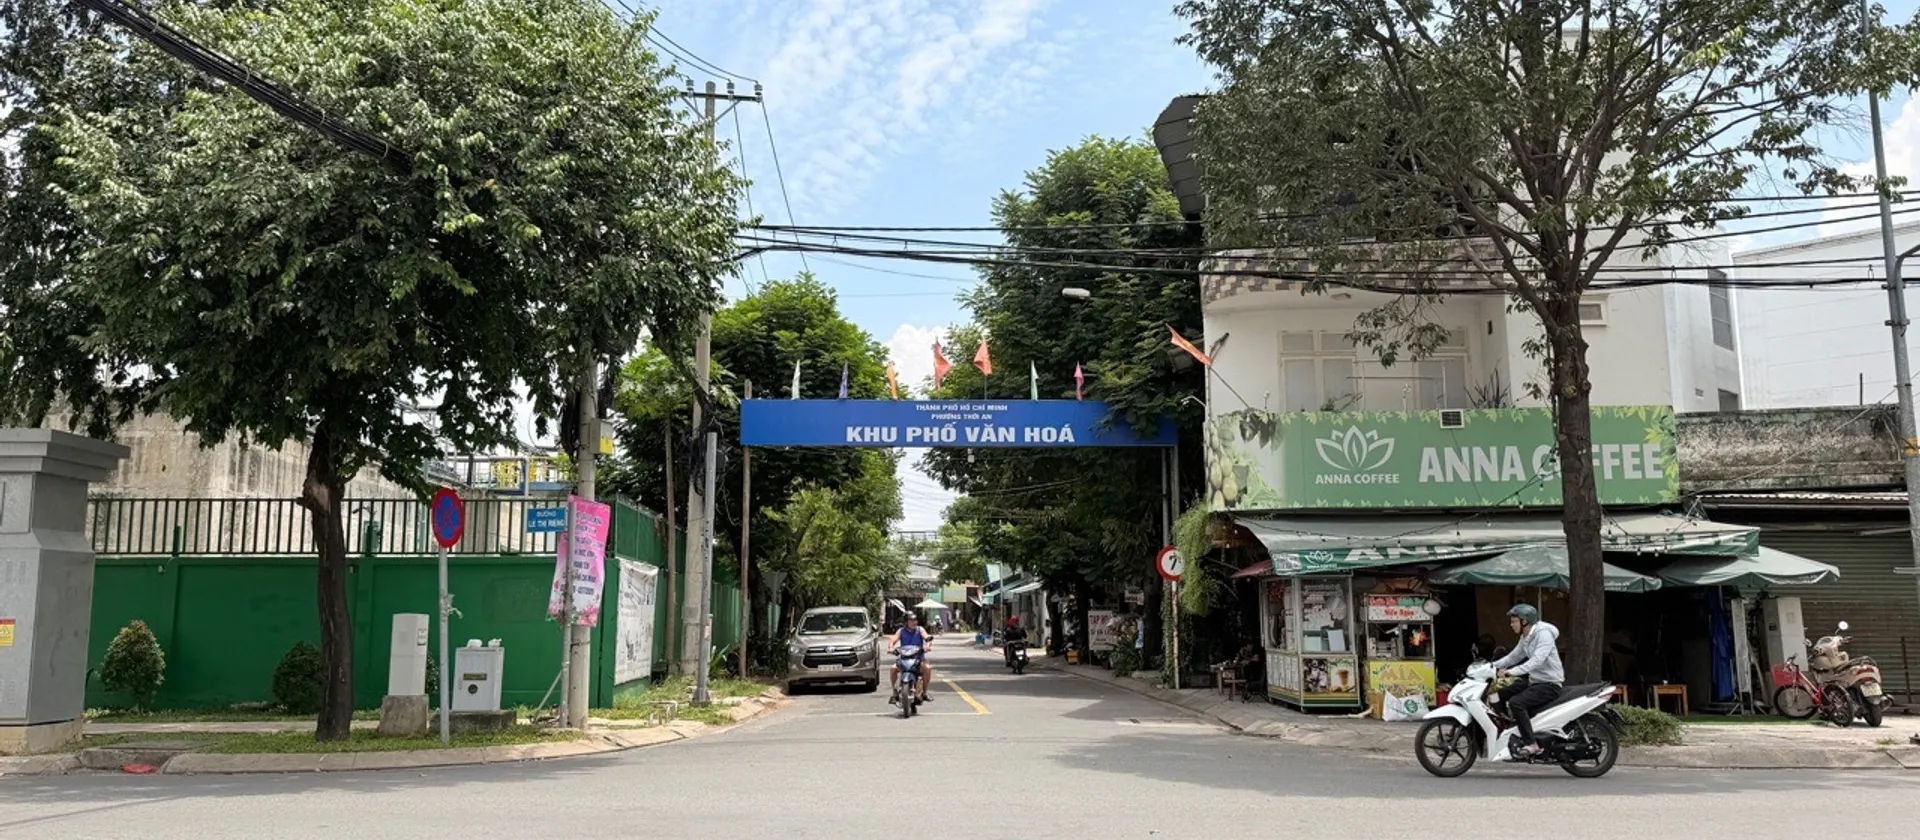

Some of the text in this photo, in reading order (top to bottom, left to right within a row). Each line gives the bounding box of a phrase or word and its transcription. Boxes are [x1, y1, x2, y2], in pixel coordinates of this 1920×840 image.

[915, 403, 941, 411] THÀNH
[972, 403, 985, 411] CHÍ
[846, 421, 1075, 443] KHU PHỐ VĂN HOÁ
[1418, 446, 1527, 483] ANNA
[1315, 472, 1399, 484] ANNA COFFEE
